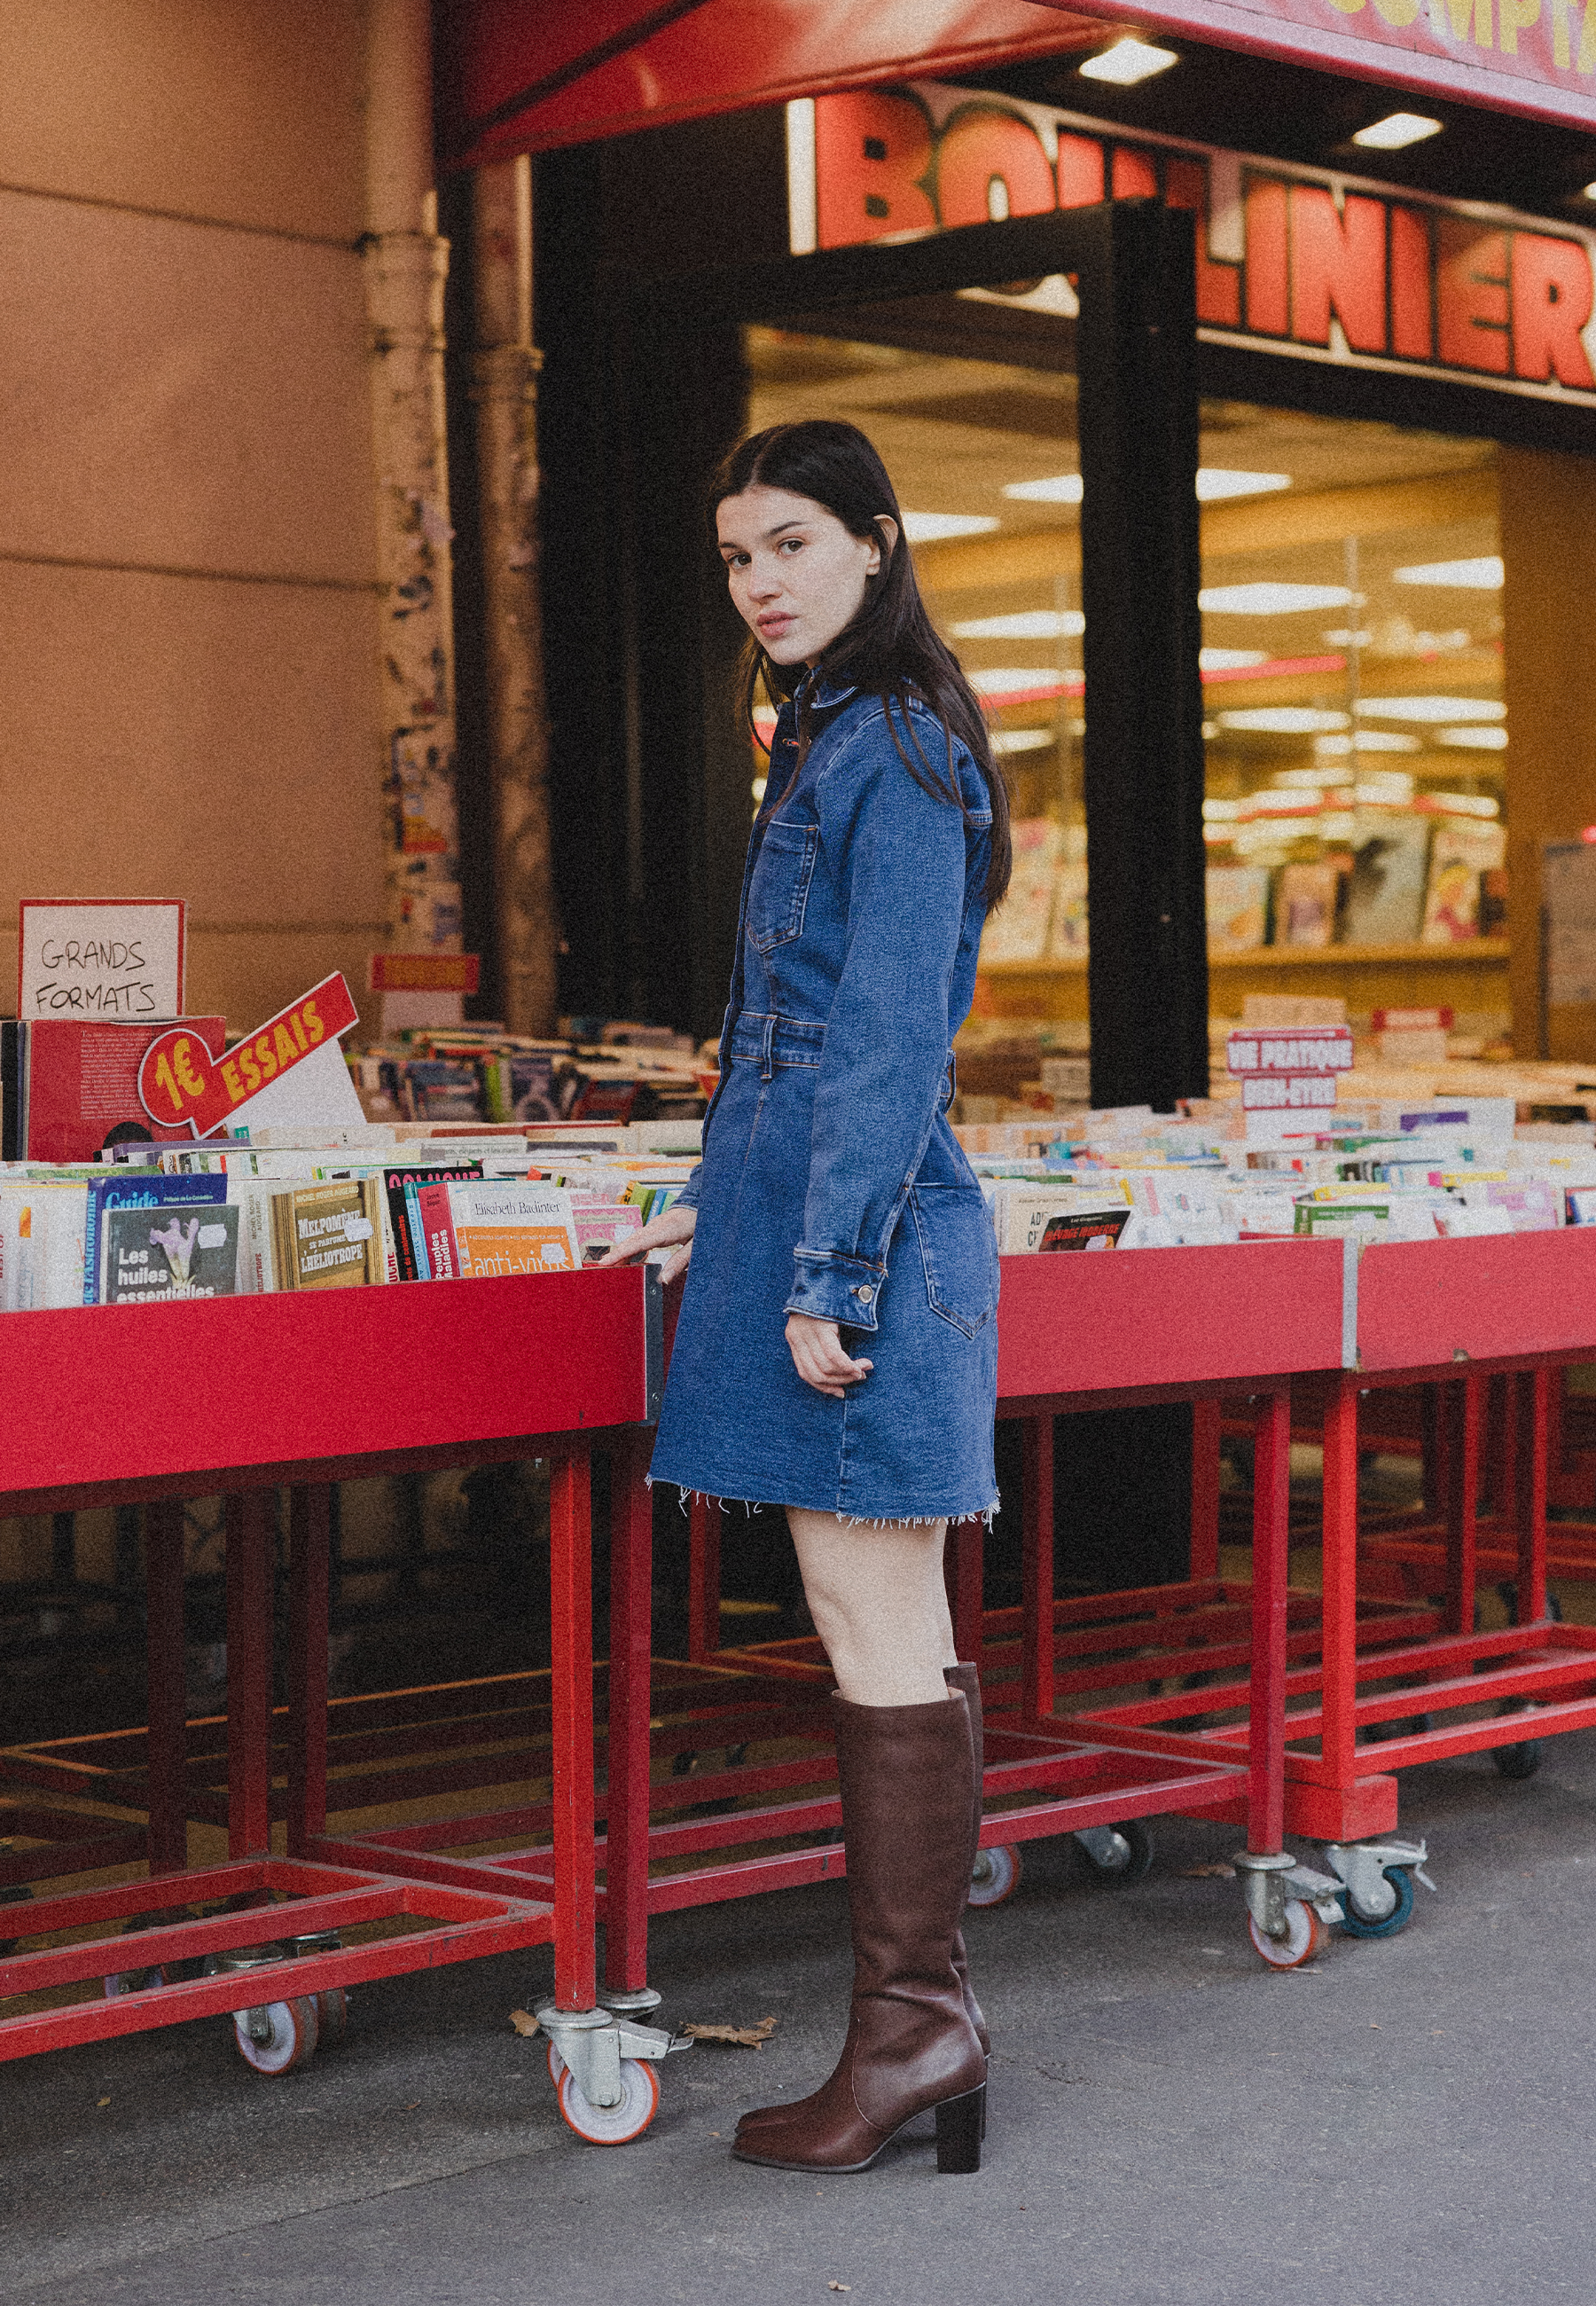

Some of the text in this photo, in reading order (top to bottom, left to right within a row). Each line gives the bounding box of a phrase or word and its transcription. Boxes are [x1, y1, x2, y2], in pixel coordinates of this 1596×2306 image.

[41, 939, 146, 971] GRANDS
[36, 982, 156, 1012] FORMATS
[154, 1039, 206, 1111] 1€
[220, 1000, 325, 1103] ESSAIS
[1261, 1039, 1353, 1072] PRATIQUE
[106, 1191, 159, 1210] Guide
[295, 1186, 359, 1204] MICHEL ROGER AUGEARD
[474, 1201, 517, 1216] Elisabeth
[518, 1200, 561, 1215] Badinter
[118, 1248, 149, 1266] Les
[431, 1232, 443, 1279] Peuples
[117, 1267, 168, 1286] huiles
[116, 1284, 215, 1303] essentielles
